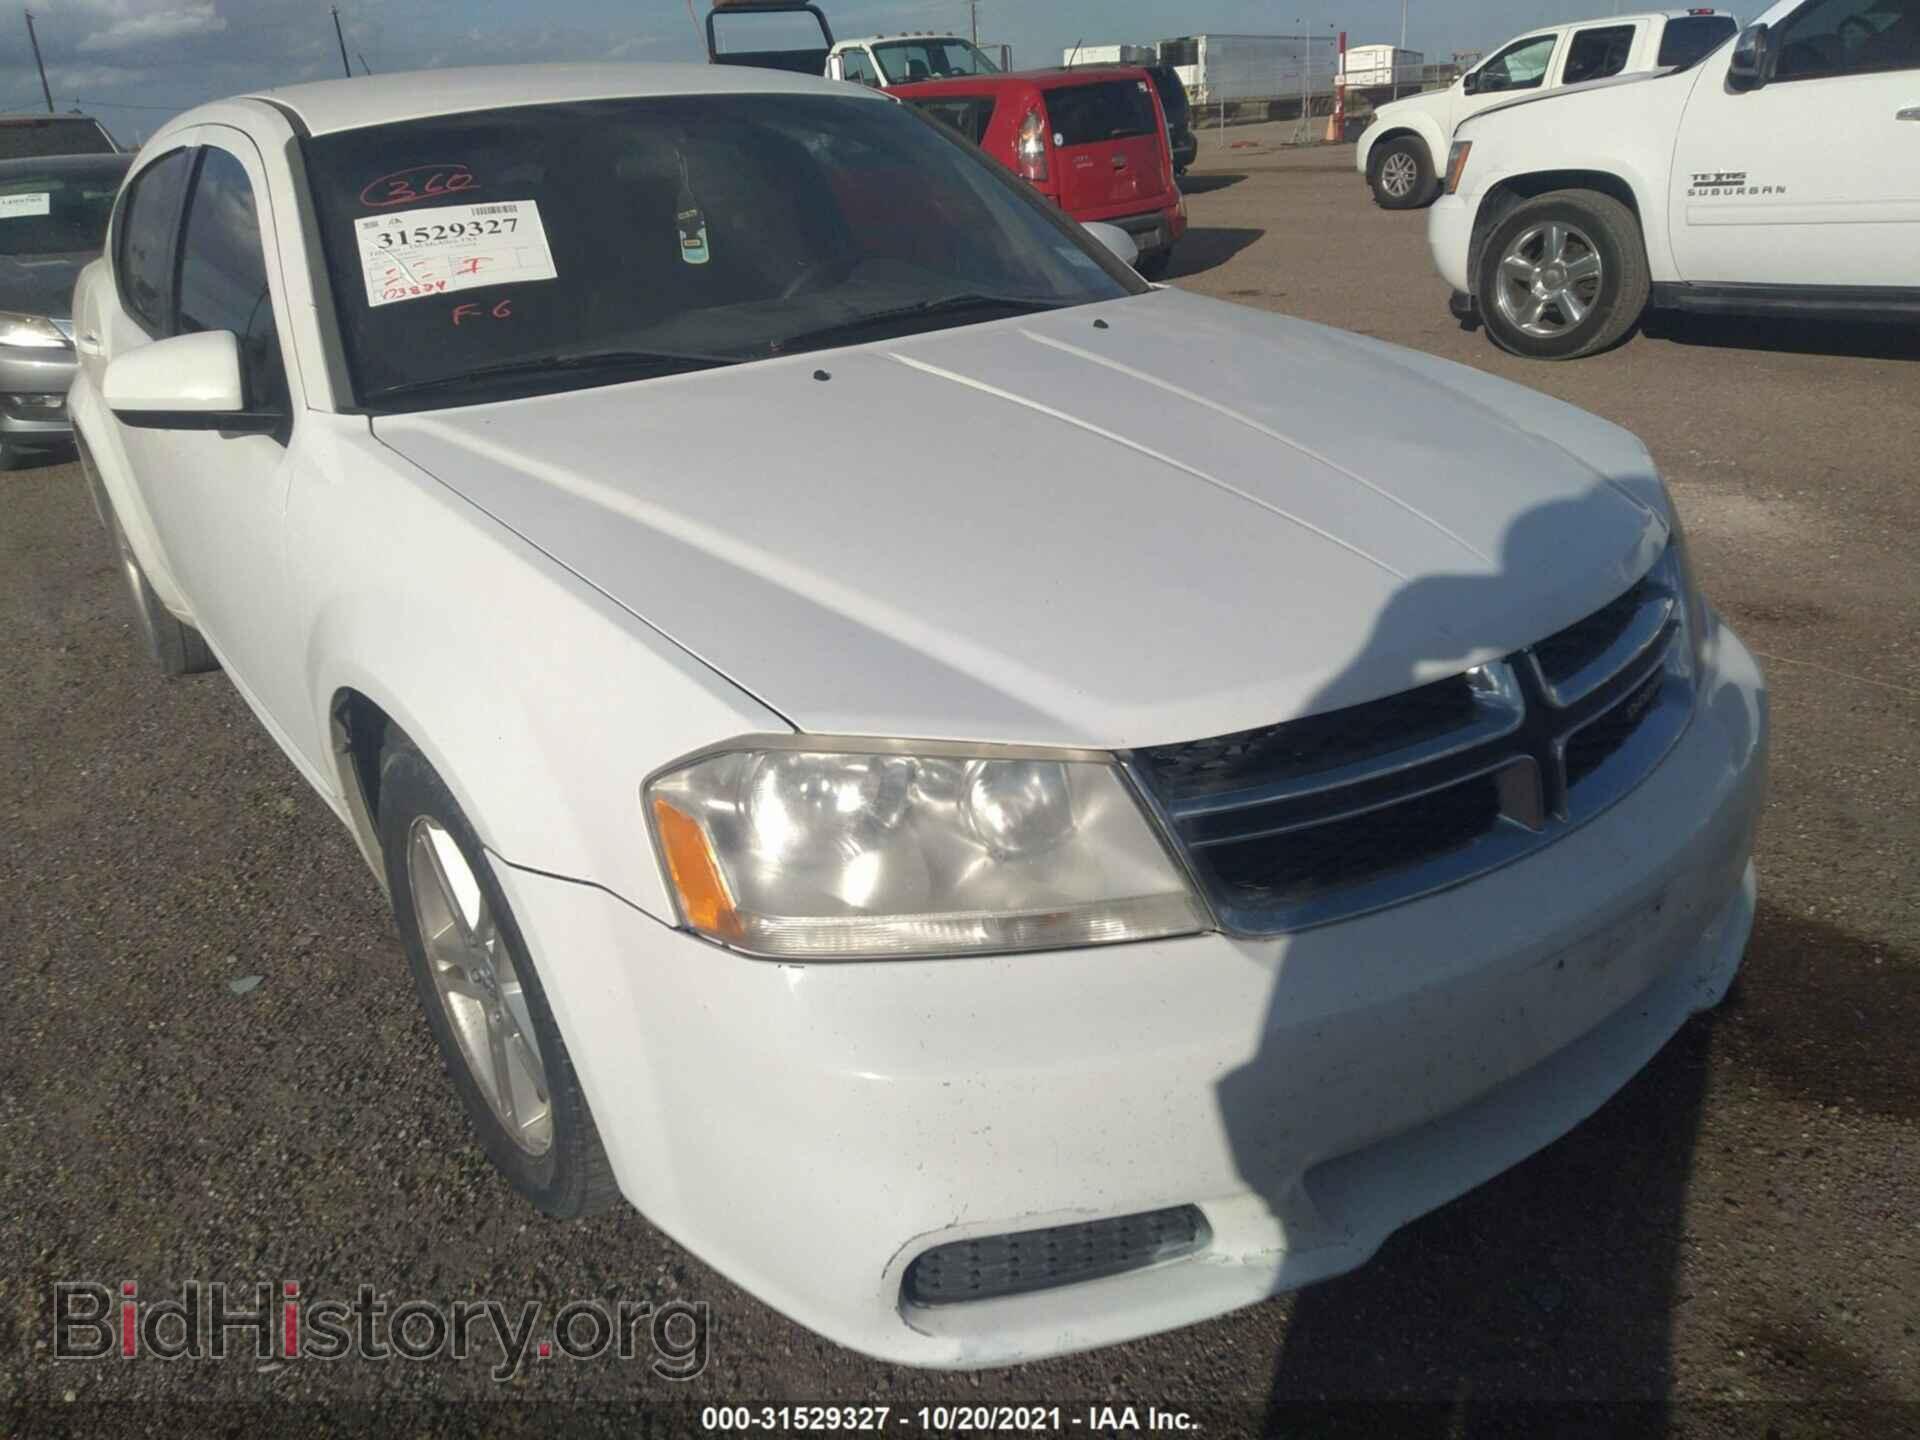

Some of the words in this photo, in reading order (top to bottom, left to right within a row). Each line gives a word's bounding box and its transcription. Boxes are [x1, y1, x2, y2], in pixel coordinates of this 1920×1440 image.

[1691, 172, 1746, 181] TEXAS
[1687, 186, 1786, 197] SUBURBAN
[377, 217, 518, 249] 31529327
